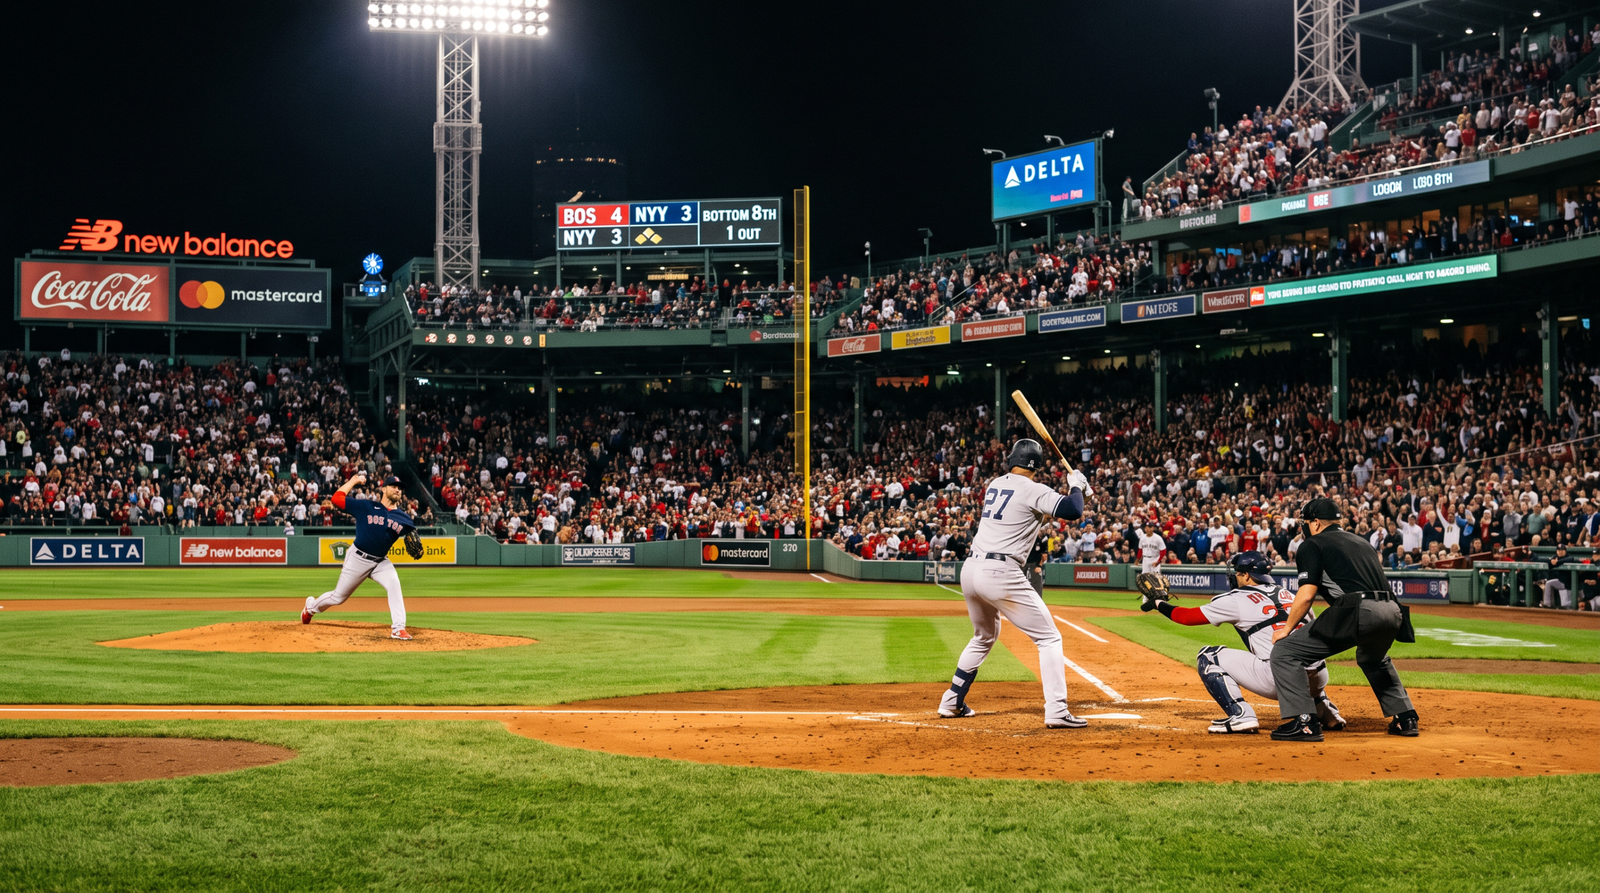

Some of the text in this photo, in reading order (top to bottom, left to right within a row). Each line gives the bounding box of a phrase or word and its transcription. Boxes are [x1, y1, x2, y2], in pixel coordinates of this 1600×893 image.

[1024, 153, 1084, 182] DELTA
[563, 206, 623, 225] BOS 4
[635, 205, 692, 223] NYY 3
[702, 204, 777, 222] BOTTOM 8TH
[563, 228, 622, 246] NYY 3
[726, 224, 762, 240] 1 OUT
[124, 234, 180, 254] new
[184, 231, 294, 259] balance
[31, 270, 158, 312] Coca-Cola
[231, 289, 322, 303] mastercard
[982, 487, 1016, 521] 27
[62, 543, 140, 559] DELTA
[210, 547, 234, 558] new
[235, 546, 283, 558] balance
[720, 547, 768, 559] mastercard
[782, 543, 798, 552] 370
